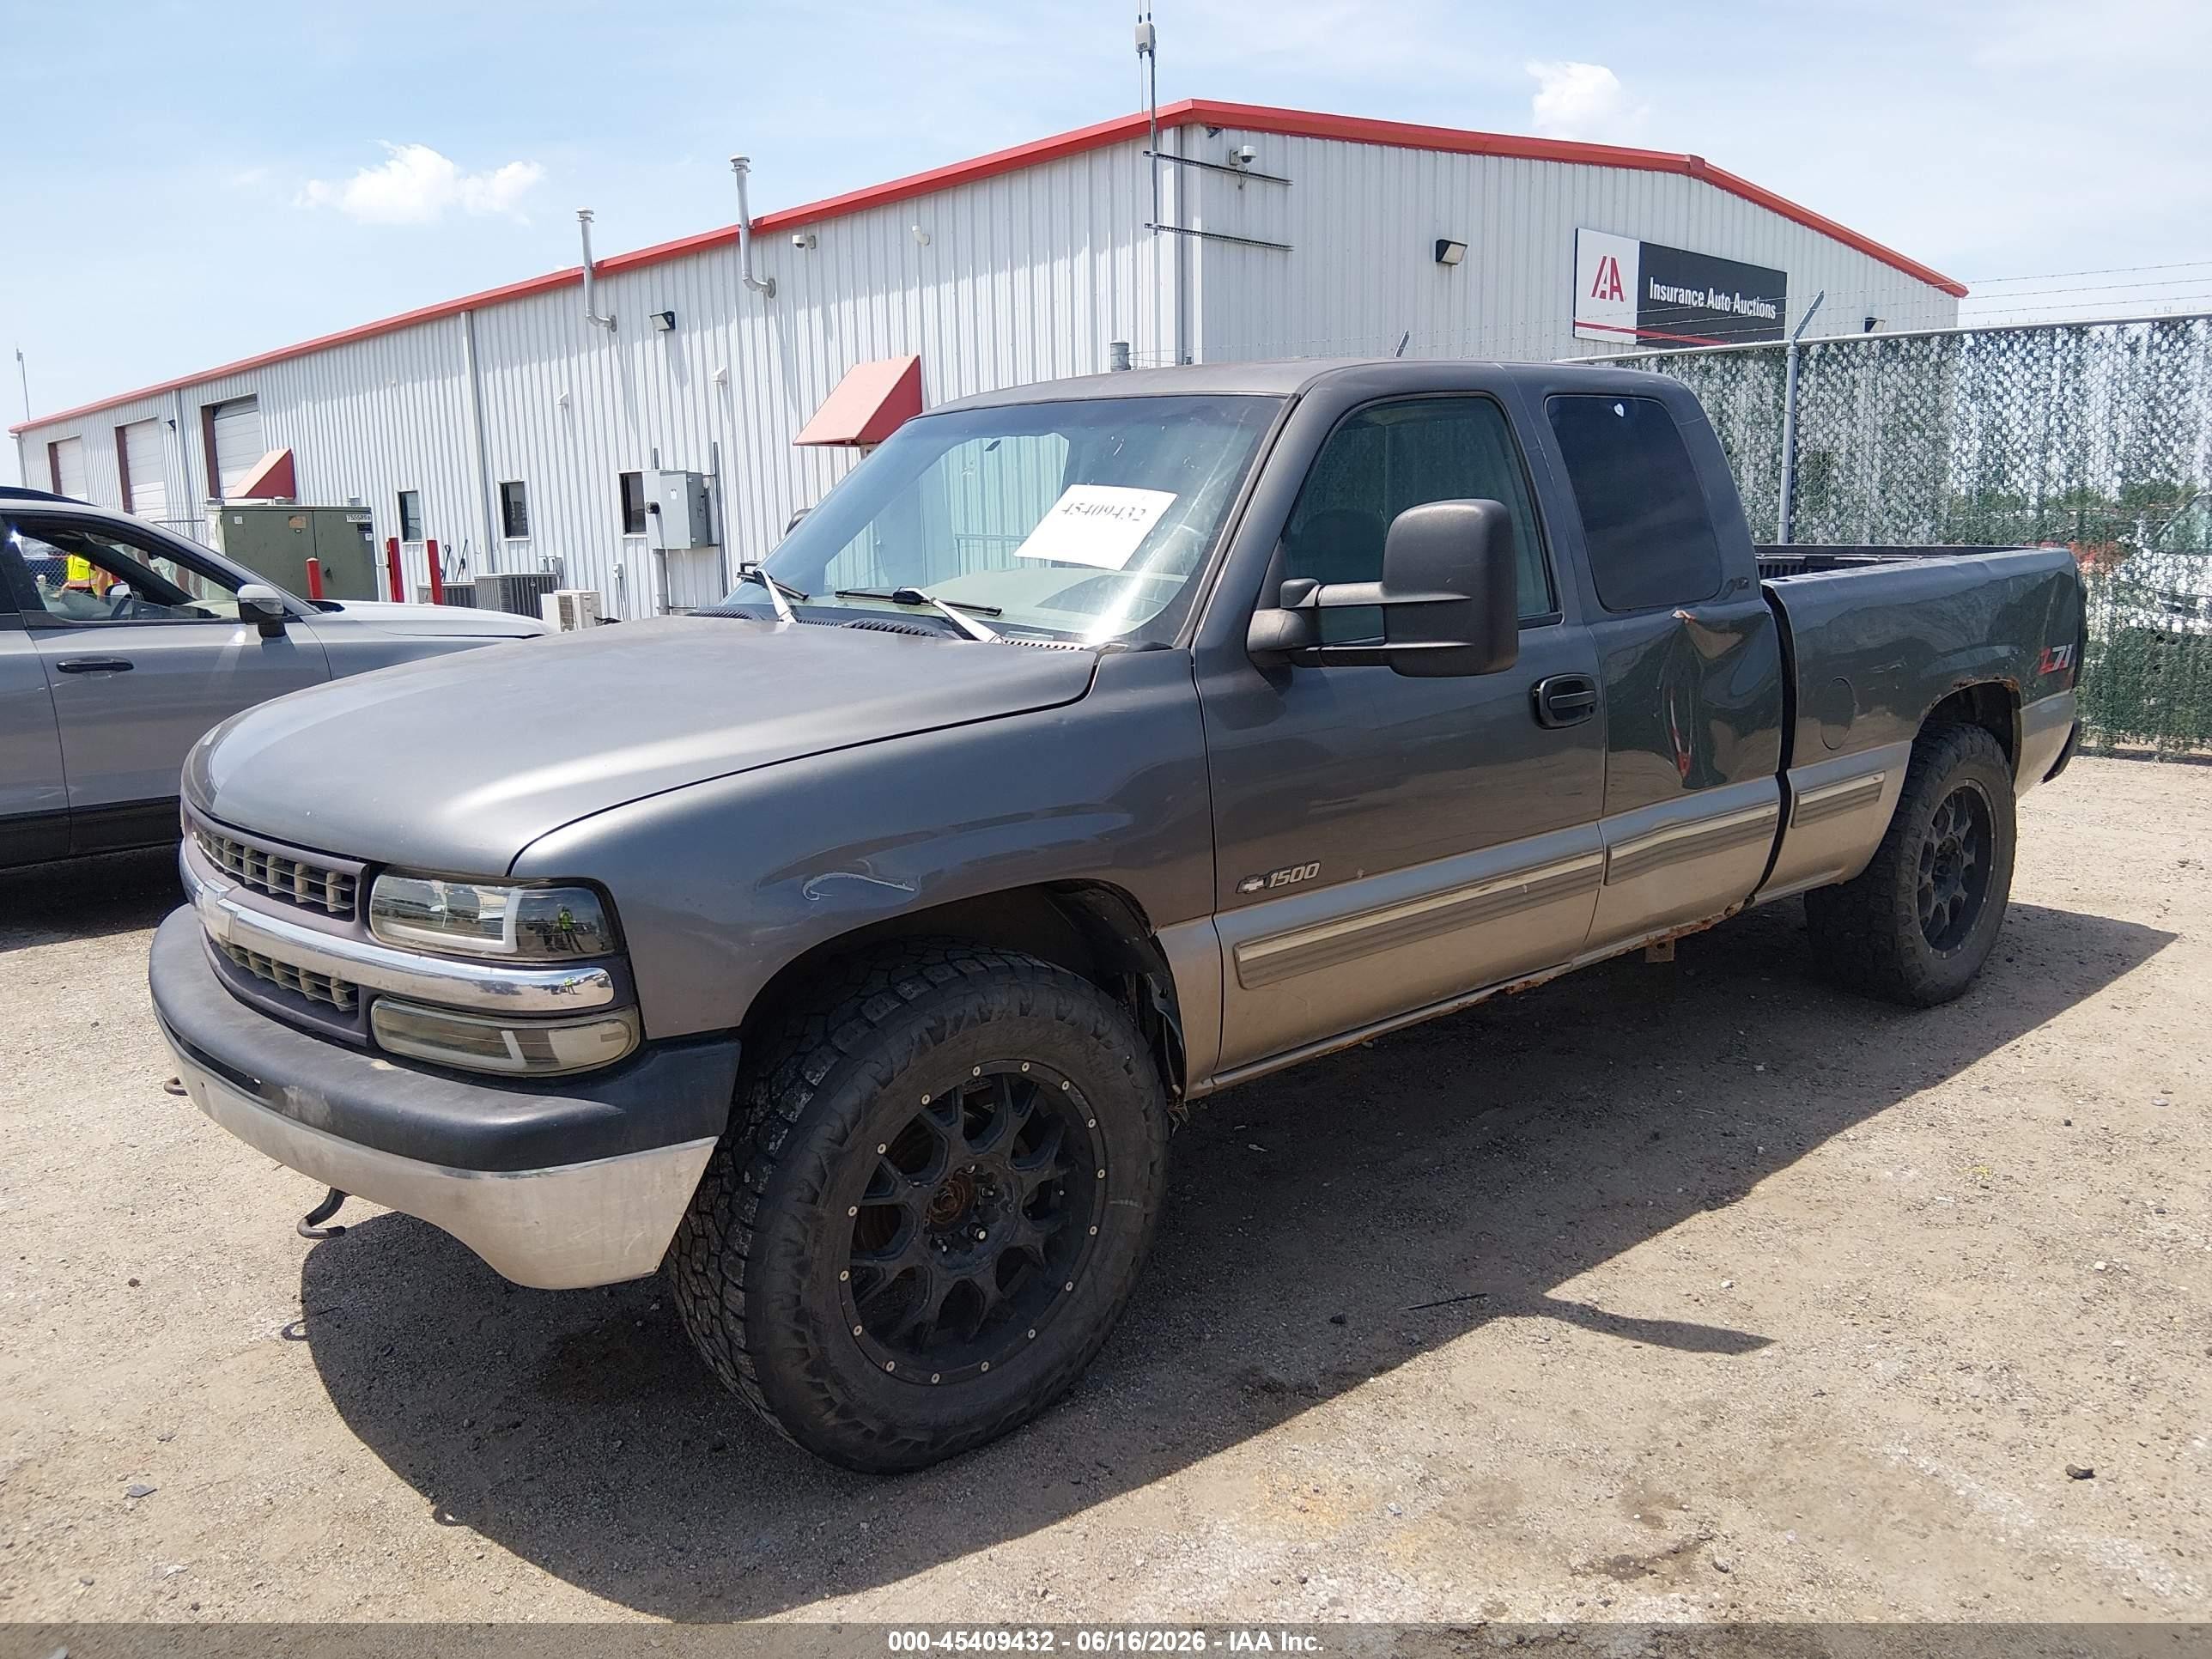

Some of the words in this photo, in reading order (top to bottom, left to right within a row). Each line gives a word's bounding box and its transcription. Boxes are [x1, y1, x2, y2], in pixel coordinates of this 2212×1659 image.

[1649, 276, 1705, 306] Insurance
[1706, 287, 1730, 312] Auto
[1733, 292, 1776, 319] Auctions
[2037, 643, 2072, 676] Z71
[1269, 862, 1321, 888] 1500
